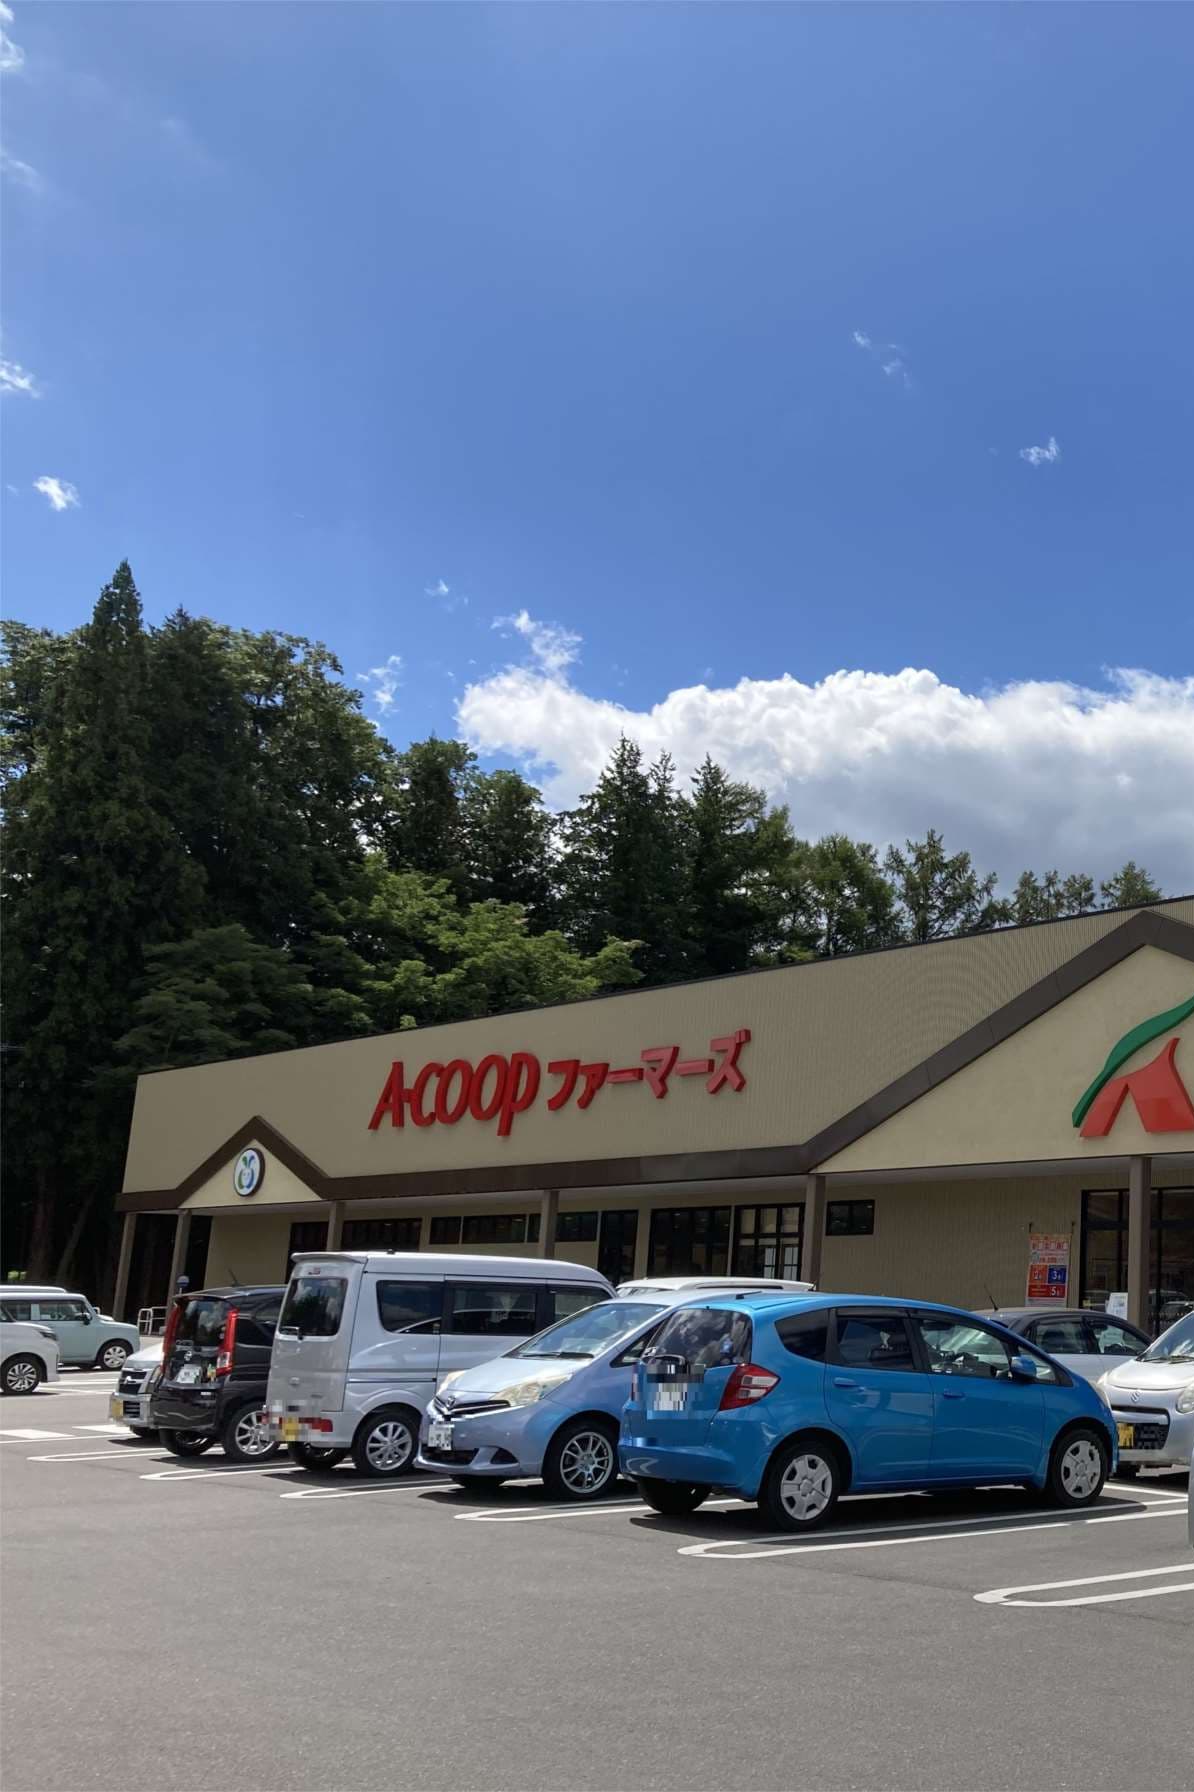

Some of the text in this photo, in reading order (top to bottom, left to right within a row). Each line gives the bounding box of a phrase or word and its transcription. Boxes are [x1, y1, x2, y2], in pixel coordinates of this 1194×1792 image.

[547, 1028, 752, 1112] ファーマーズ
